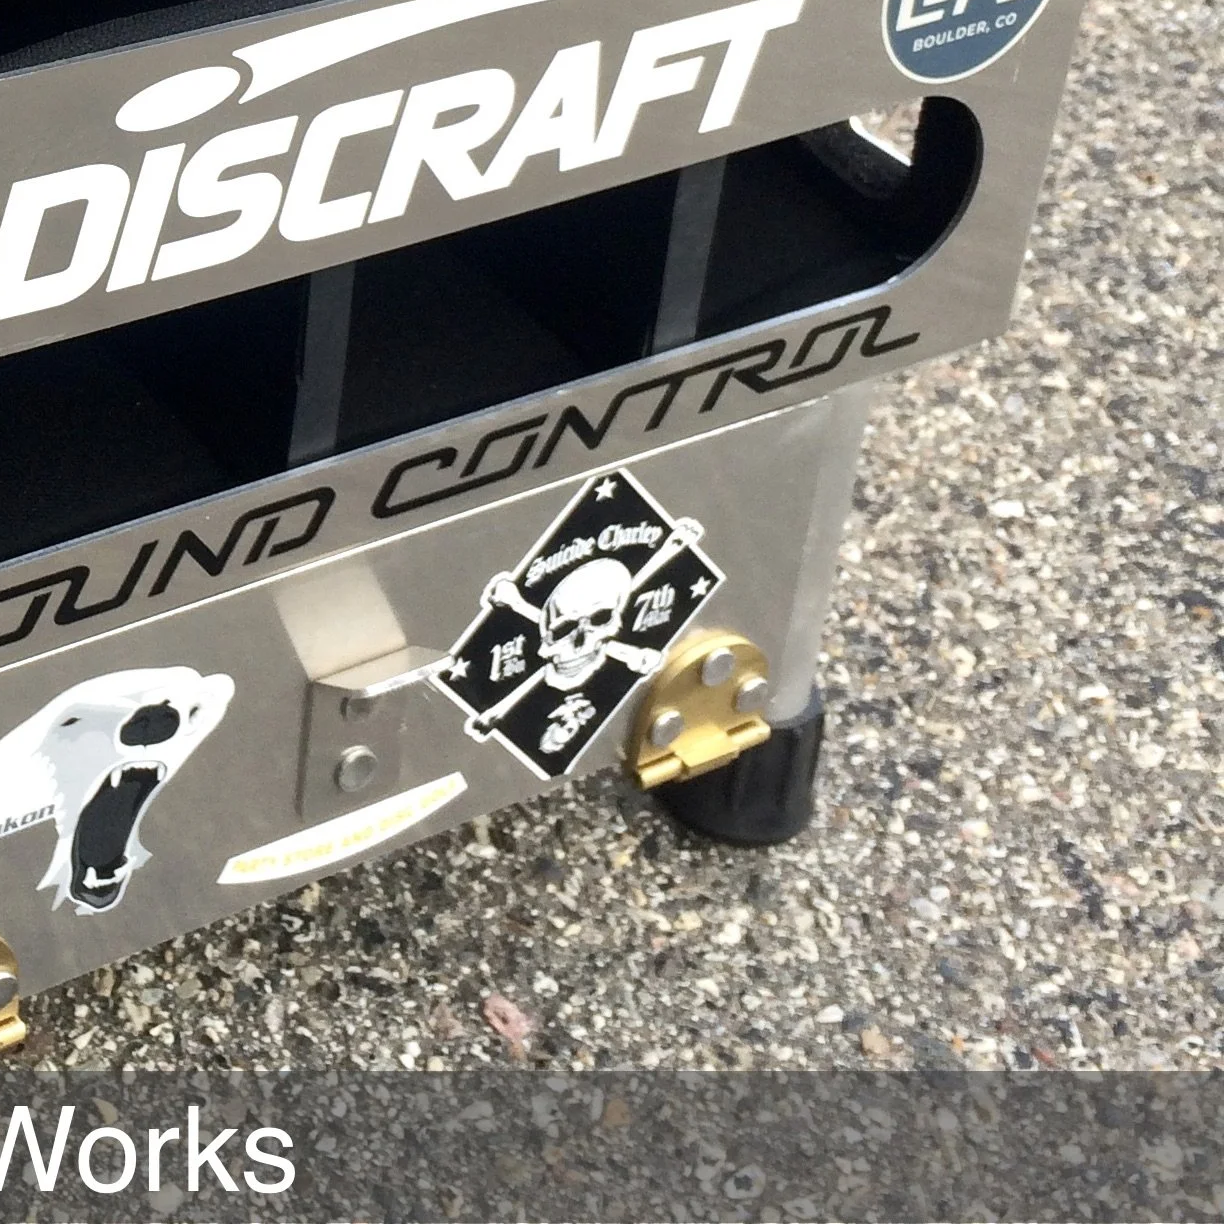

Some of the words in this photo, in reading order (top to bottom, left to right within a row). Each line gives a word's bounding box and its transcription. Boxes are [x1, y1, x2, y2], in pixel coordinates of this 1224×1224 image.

[912, 21, 991, 52] BOULDER,
[995, 12, 1017, 29] CO
[371, 304, 920, 518] CONTROL
[633, 582, 676, 632] 7th
[489, 633, 526, 682] 1st
